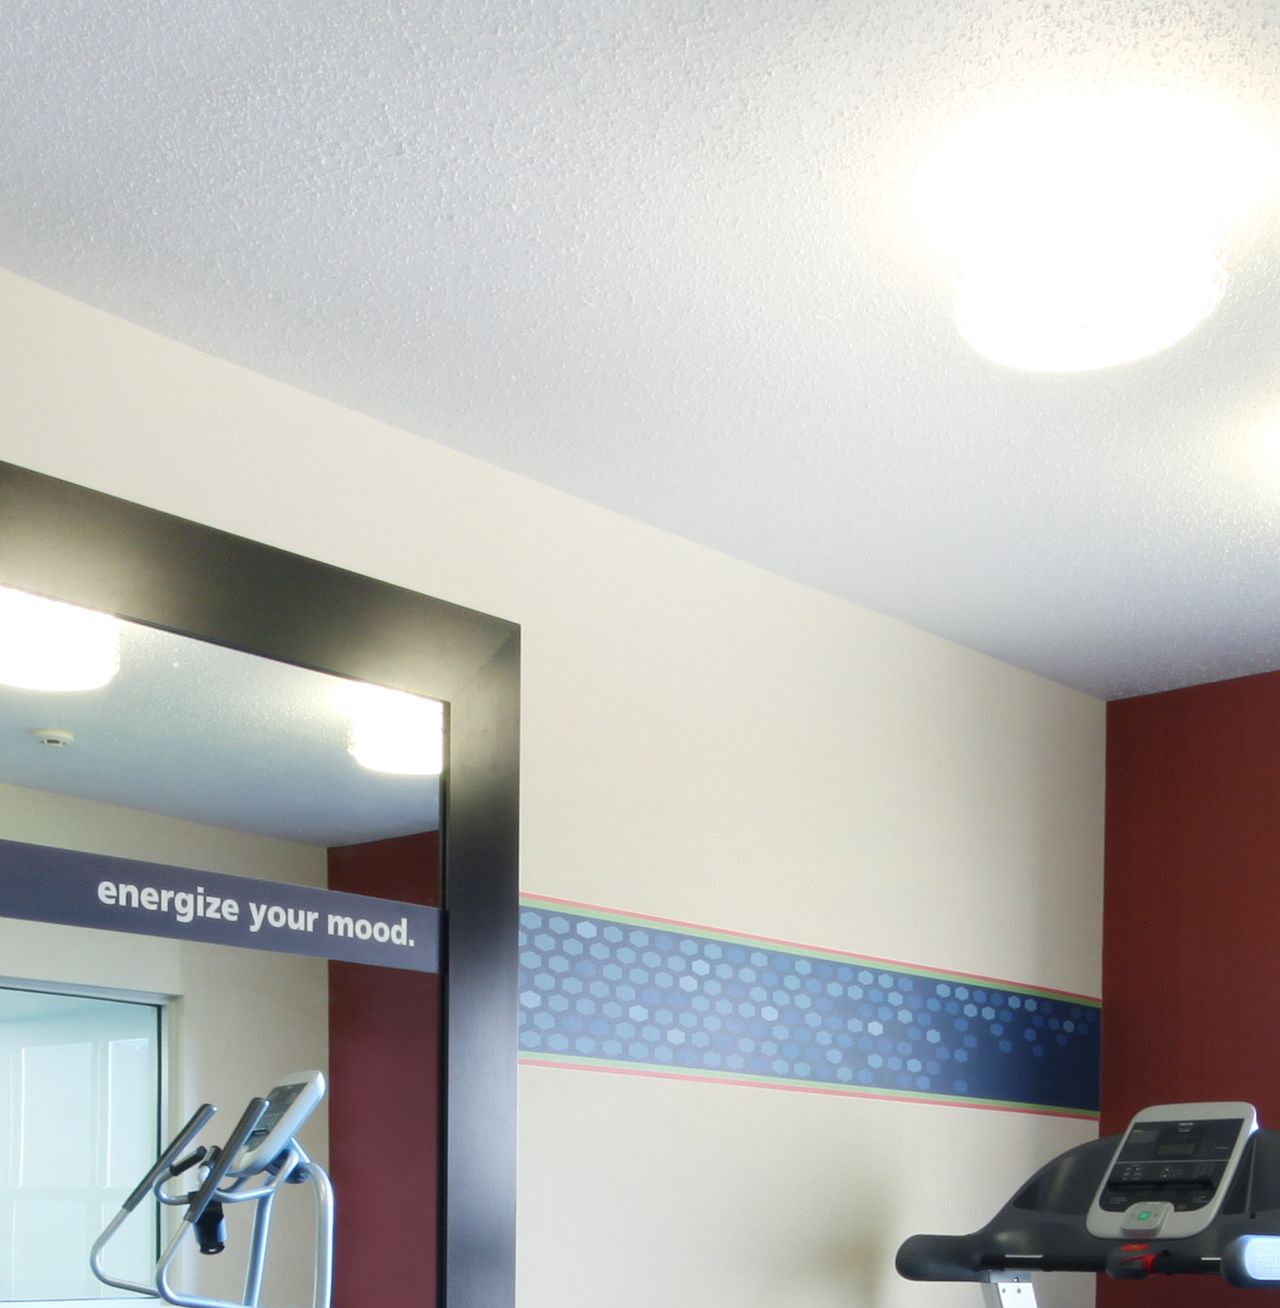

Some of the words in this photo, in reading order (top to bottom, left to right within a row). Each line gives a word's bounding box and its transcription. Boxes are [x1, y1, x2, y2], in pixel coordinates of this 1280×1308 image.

[97, 881, 239, 922] energize
[249, 902, 318, 932] your
[328, 912, 415, 946] mood.
